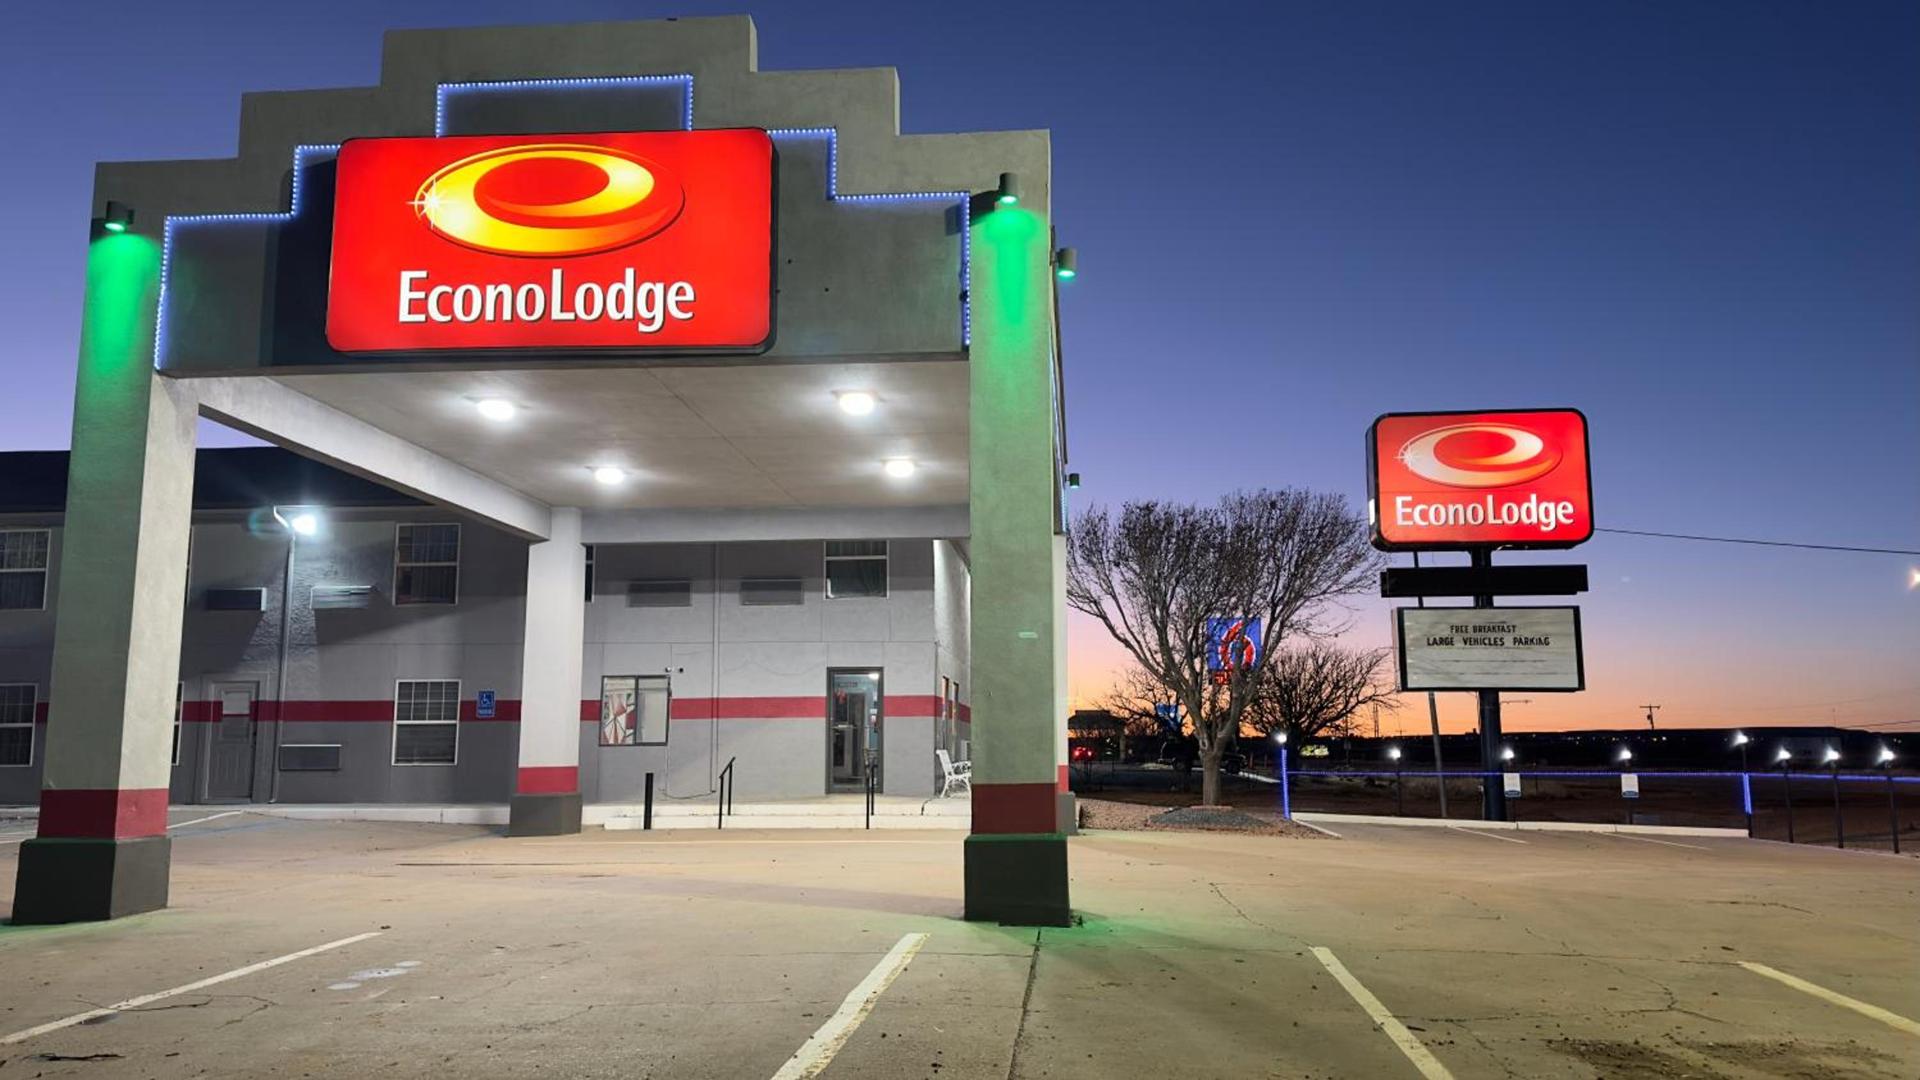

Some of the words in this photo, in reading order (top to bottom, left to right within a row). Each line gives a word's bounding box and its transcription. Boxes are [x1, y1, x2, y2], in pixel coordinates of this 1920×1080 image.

[398, 267, 695, 333] EconoLodge
[1395, 494, 1574, 531] EconoLodge
[1450, 625, 1469, 634] FREE
[1472, 625, 1517, 634] BREAKFAST
[1427, 637, 1455, 646] LARGE
[1462, 637, 1505, 646] VEHICLES
[1513, 637, 1550, 646] PARKING
